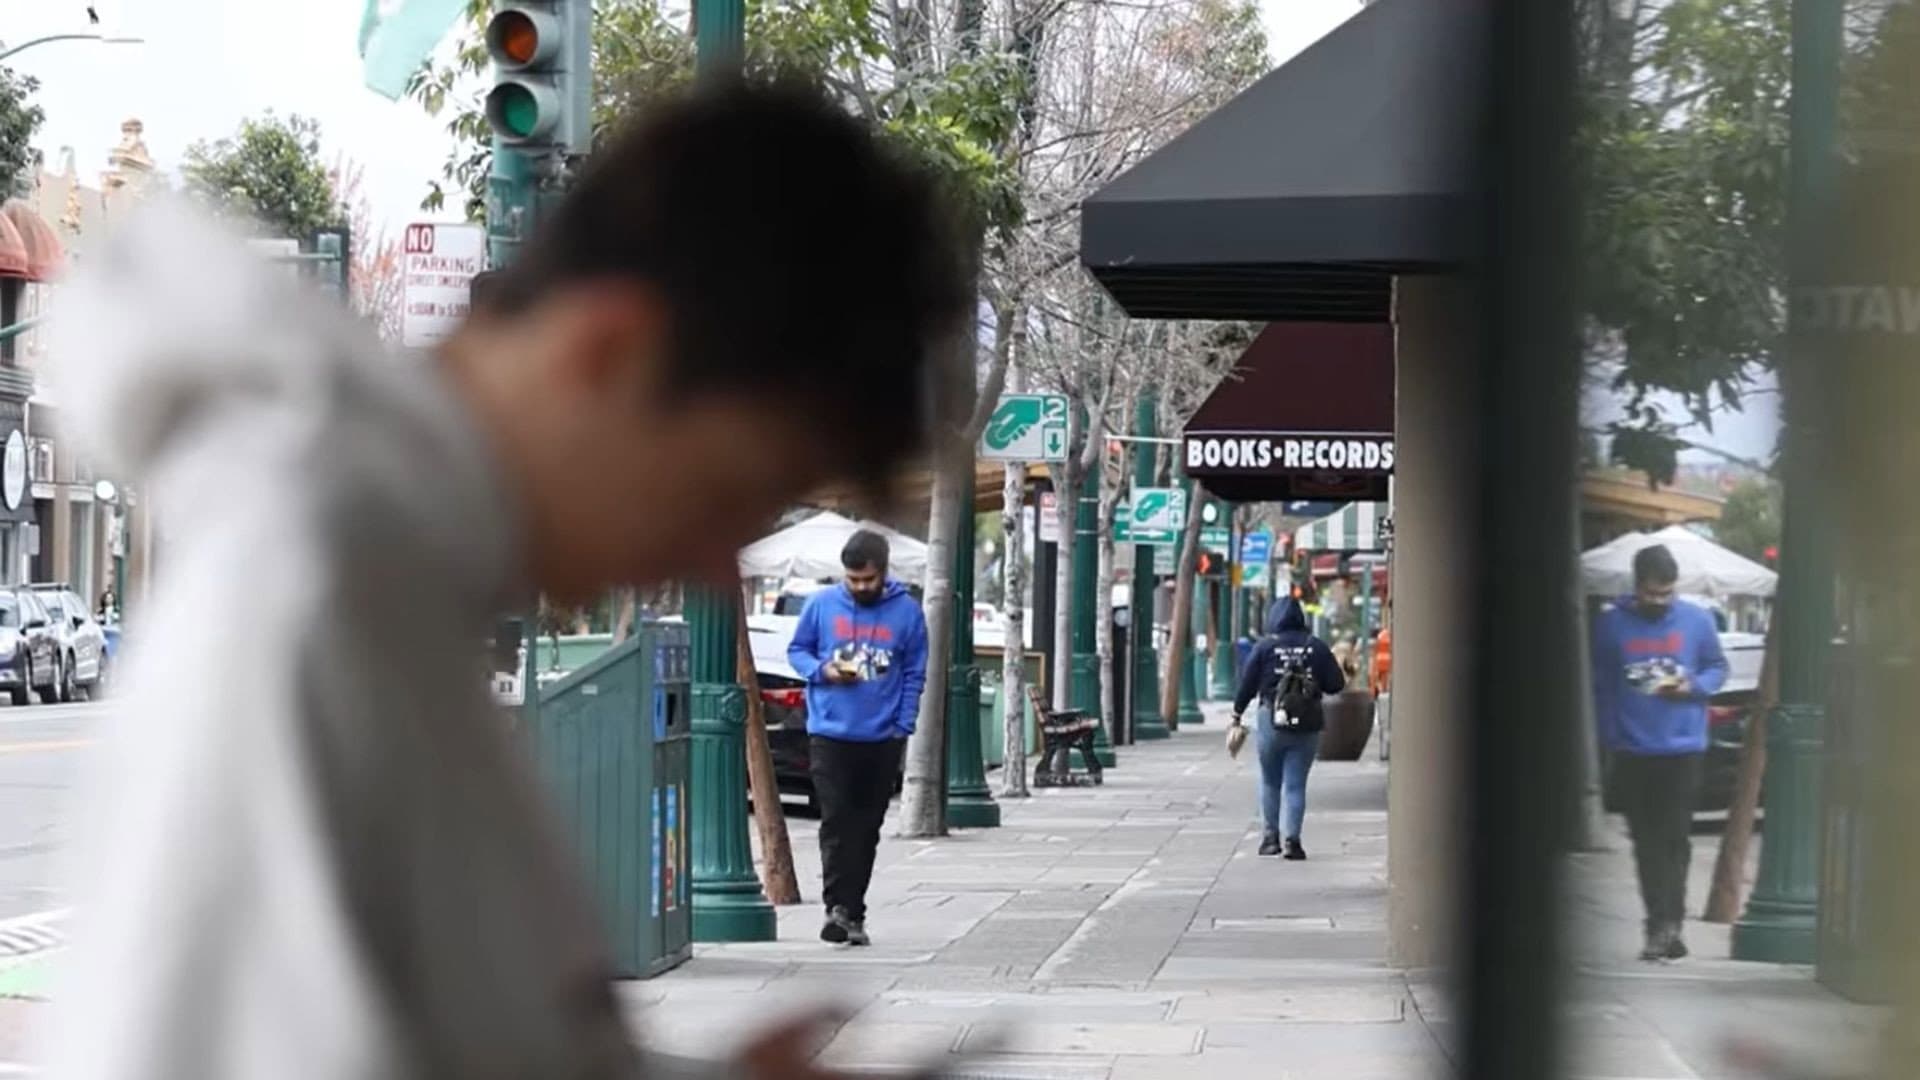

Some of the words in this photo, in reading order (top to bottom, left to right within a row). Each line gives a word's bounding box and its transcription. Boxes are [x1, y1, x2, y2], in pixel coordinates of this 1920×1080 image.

[407, 226, 432, 251] NO
[411, 256, 475, 273] PARKING
[1046, 398, 1065, 421] 2
[1187, 438, 1271, 468] BOOKS
[1284, 440, 1394, 470] RECORDS
